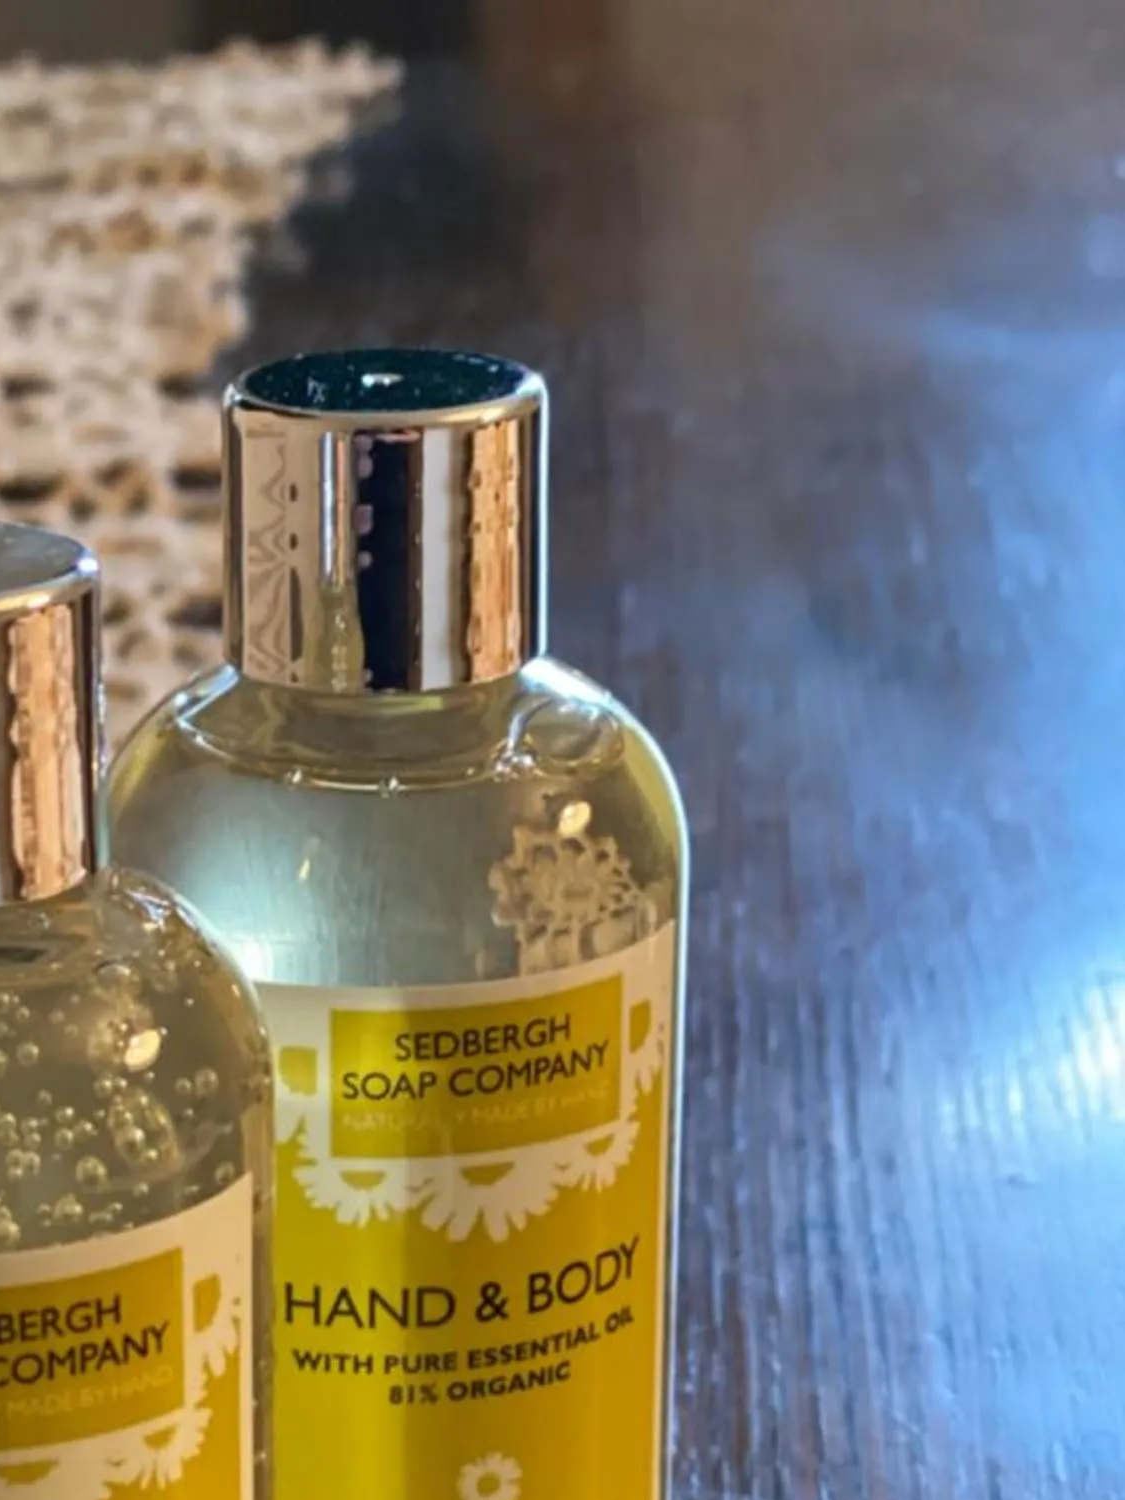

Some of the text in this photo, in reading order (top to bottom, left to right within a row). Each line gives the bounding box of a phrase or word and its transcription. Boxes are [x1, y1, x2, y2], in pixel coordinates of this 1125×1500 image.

[395, 1013, 571, 1061] SEDBERGH
[342, 1039, 609, 1100] SOAP COMPANY
[284, 1234, 639, 1329] HAND & BODY
[292, 1306, 634, 1374] WITH PURE ESSENTIAL OIL
[389, 1361, 571, 1405] 81% ORGANIC
